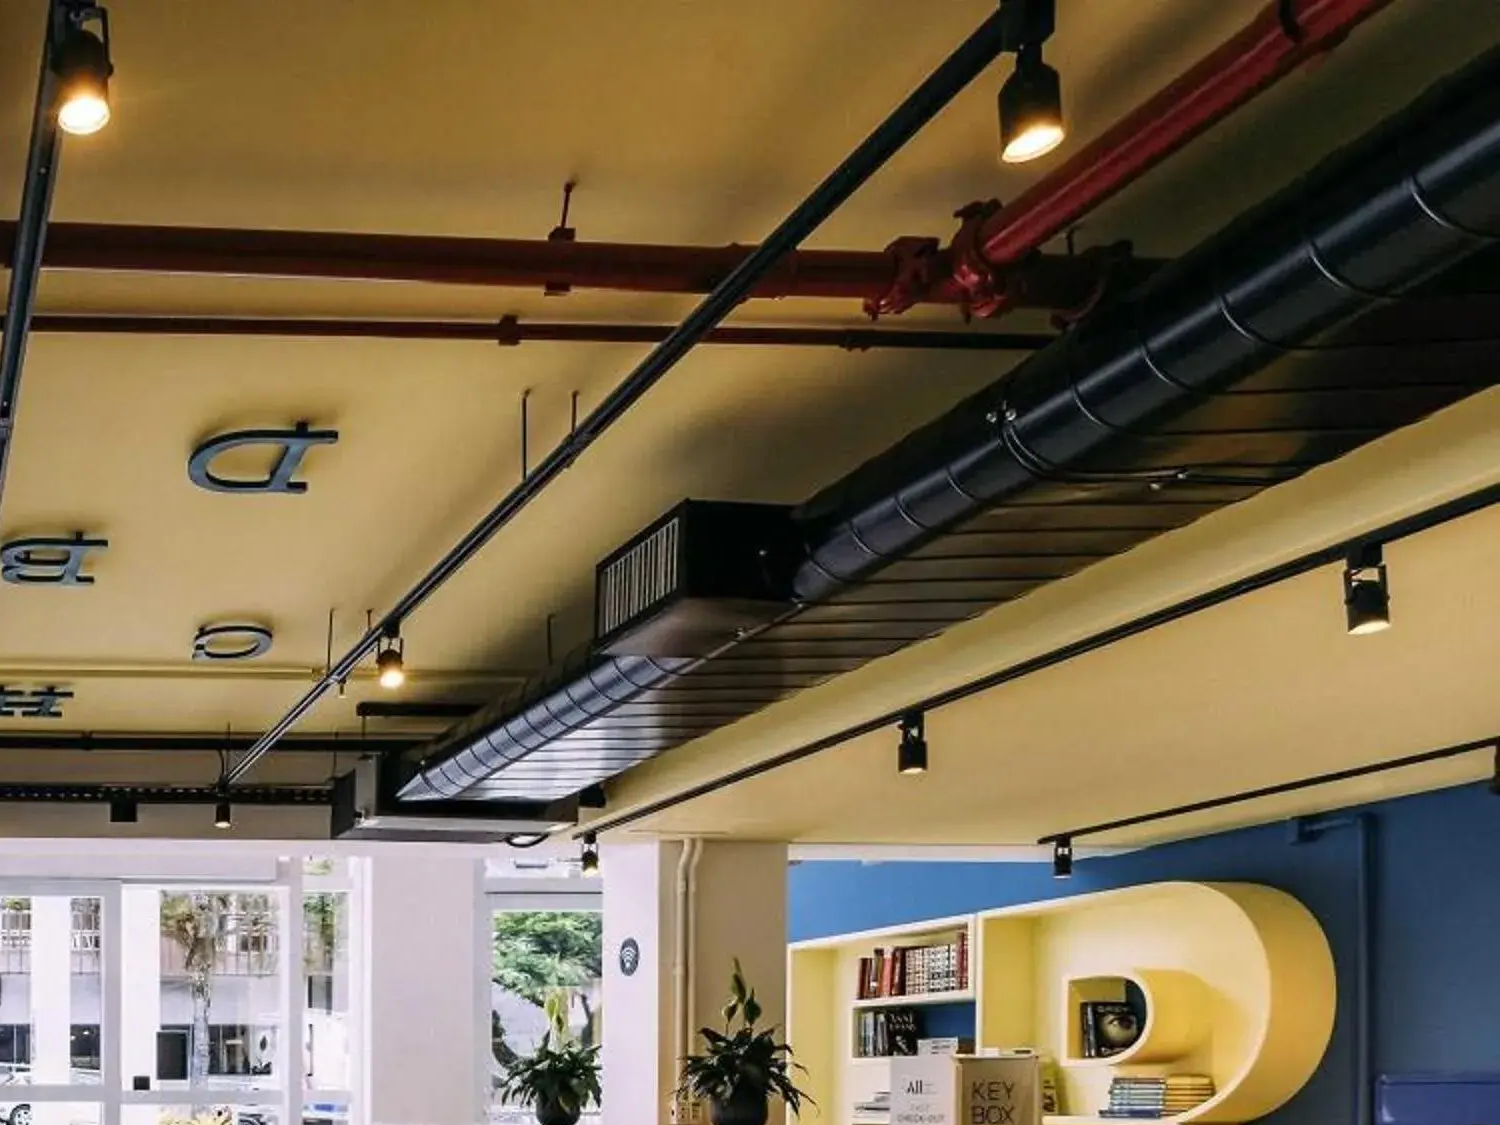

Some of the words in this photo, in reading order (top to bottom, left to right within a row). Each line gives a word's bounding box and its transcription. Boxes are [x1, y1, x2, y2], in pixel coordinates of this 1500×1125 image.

[188, 425, 339, 494] D
[0, 536, 109, 585] B
[971, 1081, 1016, 1101] KEY
[970, 1105, 1016, 1125] BOX
